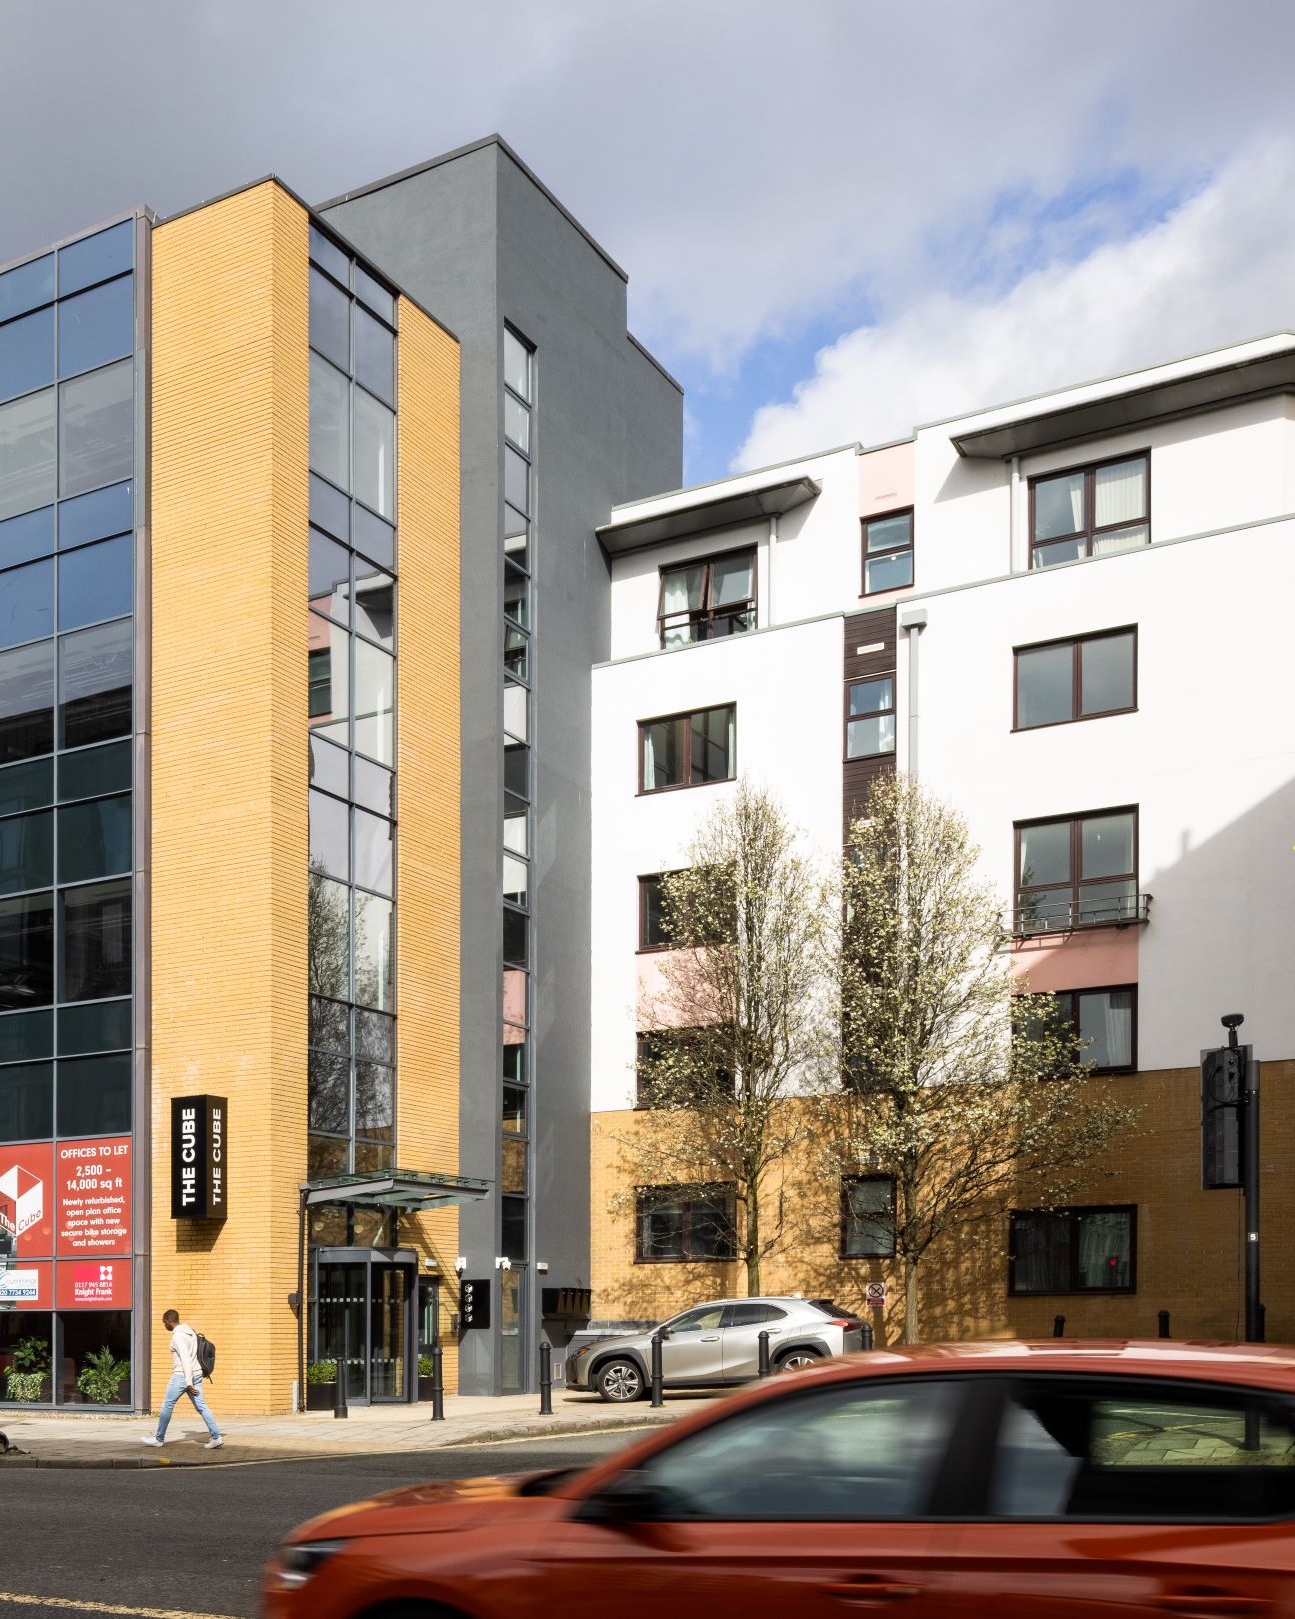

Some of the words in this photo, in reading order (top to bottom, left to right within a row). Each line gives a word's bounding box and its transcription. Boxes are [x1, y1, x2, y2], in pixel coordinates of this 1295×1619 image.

[182, 1108, 196, 1163] CUBE
[213, 1108, 221, 1162] CUBE
[60, 1147, 96, 1159] OFFICES
[98, 1146, 111, 1156] TO
[113, 1145, 128, 1155] LET
[76, 1164, 103, 1177] 2,500
[66, 1178, 98, 1191] 14,000
[100, 1181, 112, 1190] sq
[115, 1177, 123, 1188] ft
[182, 1167, 196, 1206] THE
[213, 1167, 221, 1205] THE
[62, 1197, 83, 1206] Newly
[85, 1196, 125, 1205] refurbished,
[66, 1209, 84, 1217] open
[85, 1208, 101, 1216] plan
[102, 1206, 121, 1214] office
[0, 1212, 15, 1231] The
[18, 1210, 41, 1230] Cube
[67, 1219, 88, 1227] space
[90, 1217, 104, 1225] with
[84, 1228, 99, 1236] bike
[100, 1228, 127, 1236] storage
[1250, 1233, 1256, 1241] 5
[72, 1239, 86, 1247] and
[87, 1238, 116, 1246] showers
[74, 1288, 95, 1297] Knight
[95, 1287, 113, 1296] Frank
